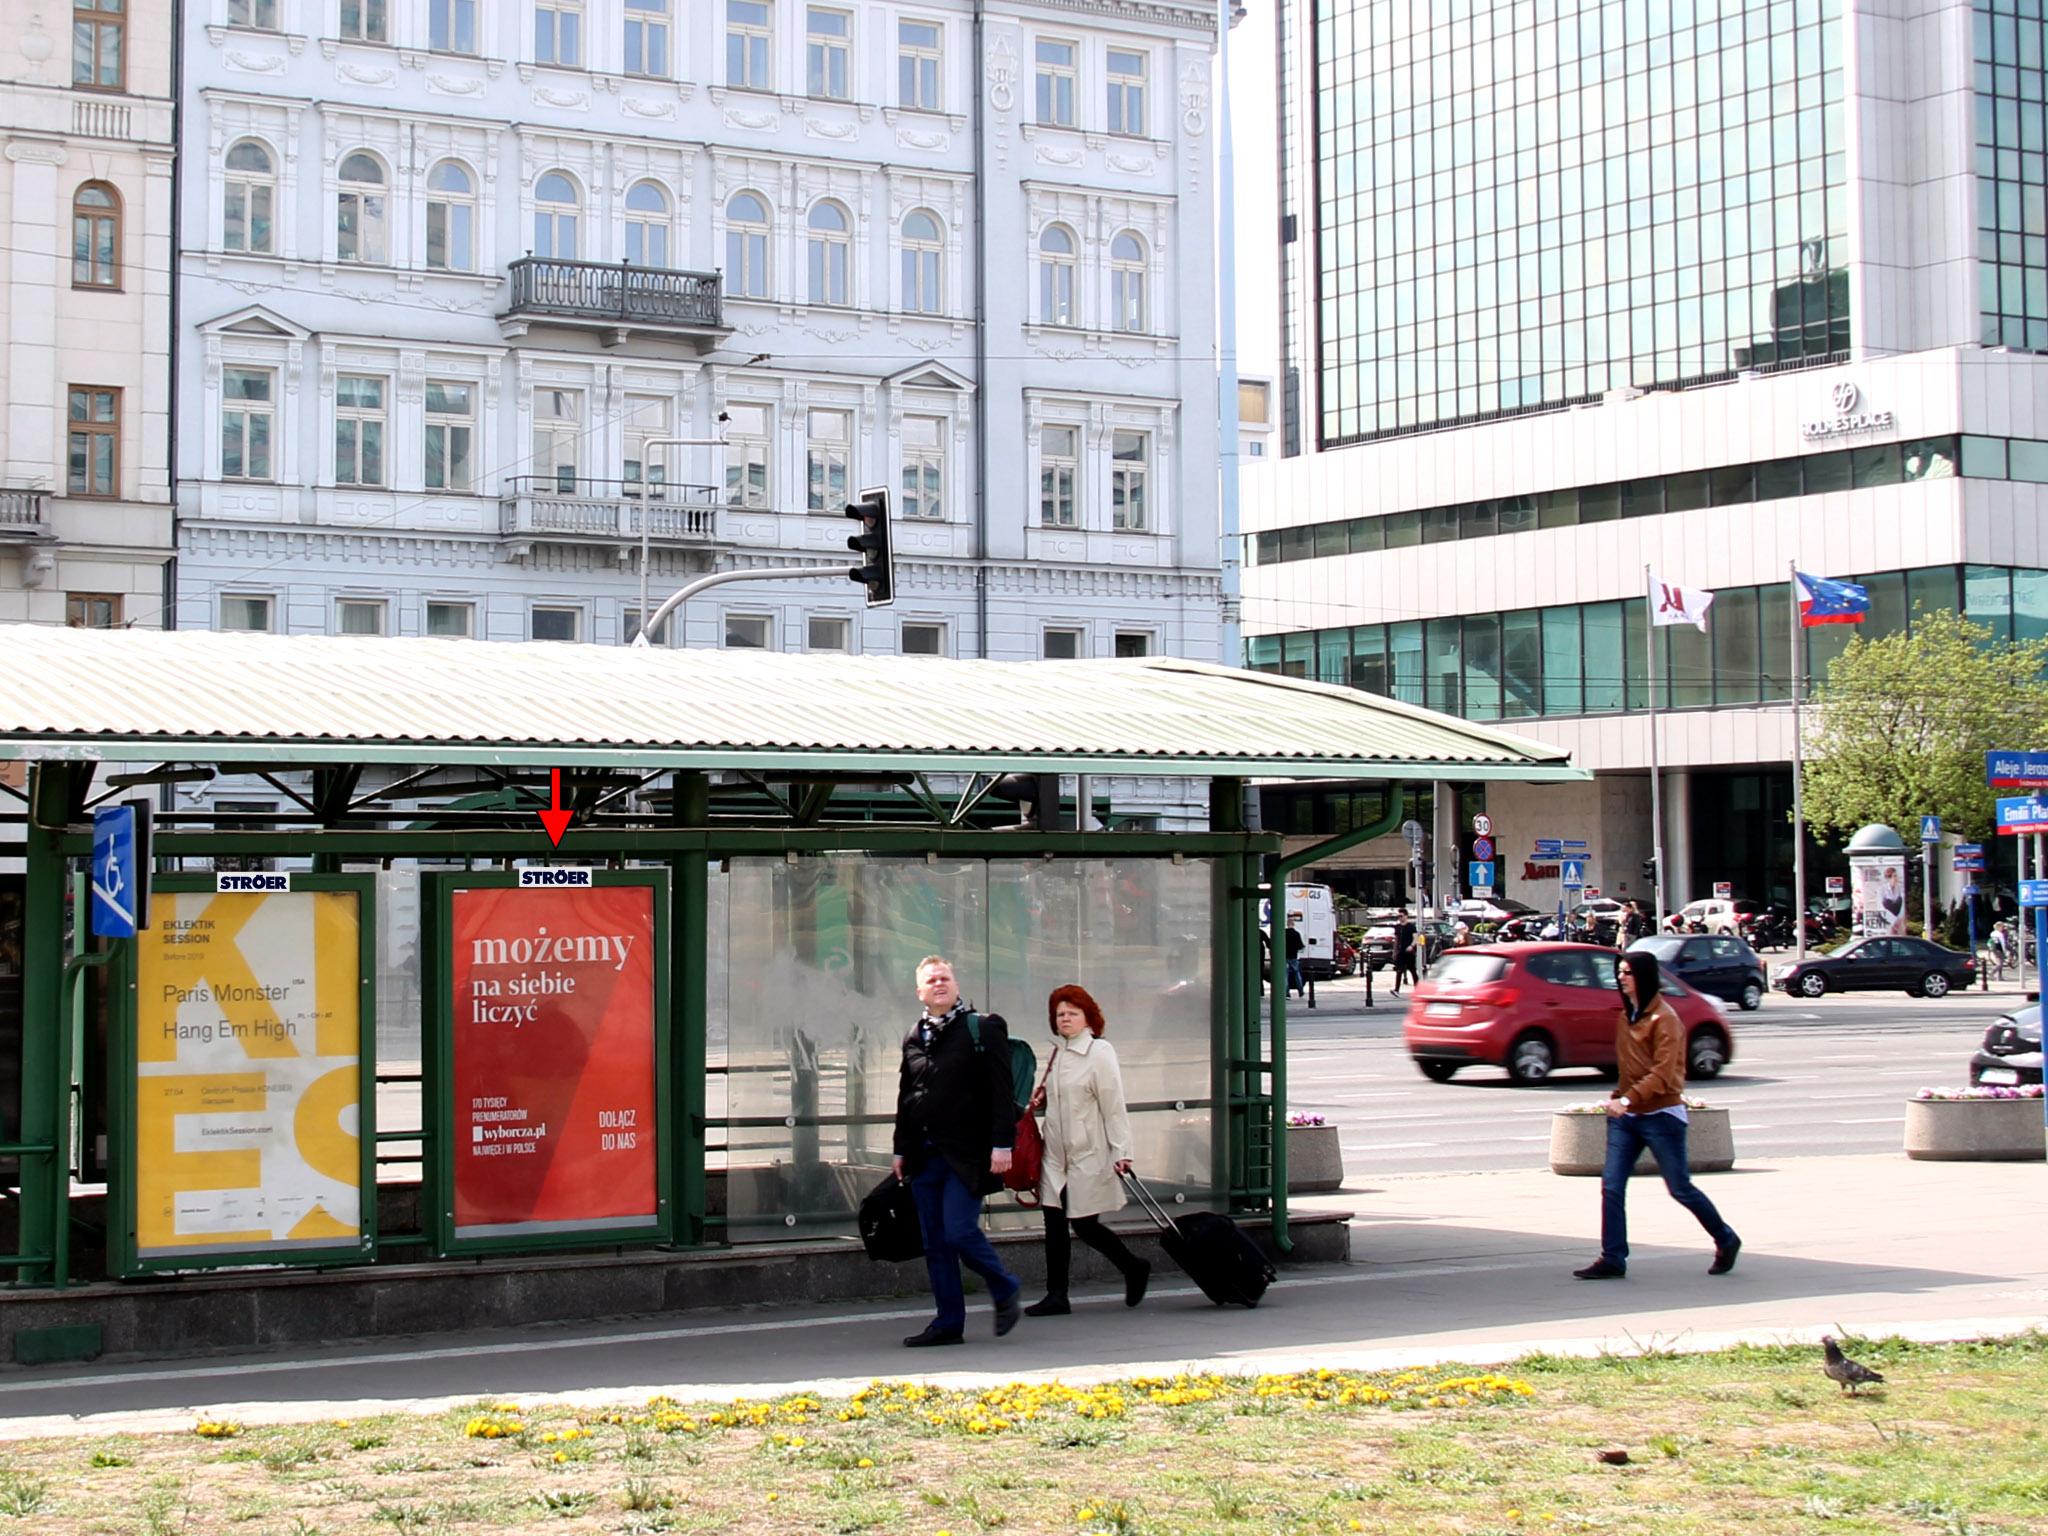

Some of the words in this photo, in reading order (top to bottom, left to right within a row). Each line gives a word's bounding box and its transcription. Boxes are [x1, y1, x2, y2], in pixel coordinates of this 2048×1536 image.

[1994, 759, 2020, 778] Aleje
[2032, 804, 2048, 819] Pla
[1476, 820, 1489, 832] 30
[1309, 890, 1321, 899] GLS
[163, 920, 215, 930] EKLEKTIK
[163, 934, 210, 944] SESSION
[472, 926, 635, 971] możemy
[164, 984, 209, 1003] Paris
[214, 983, 290, 1001] Monster
[472, 979, 501, 997] na
[508, 970, 576, 996] siebie
[472, 998, 538, 1028] liczyć
[164, 1021, 212, 1043] Hang
[218, 1020, 248, 1038] Em
[254, 1018, 296, 1041] High
[472, 1108, 528, 1122] PRENUMERATORÓW
[599, 1109, 636, 1130] DOŁĄCZ
[484, 1122, 546, 1141] wyborcza.pl
[472, 1144, 505, 1157] NAJWIĘCEJ
[513, 1142, 536, 1154] POLSCE
[601, 1133, 615, 1151] DO
[617, 1132, 636, 1150] NAS
